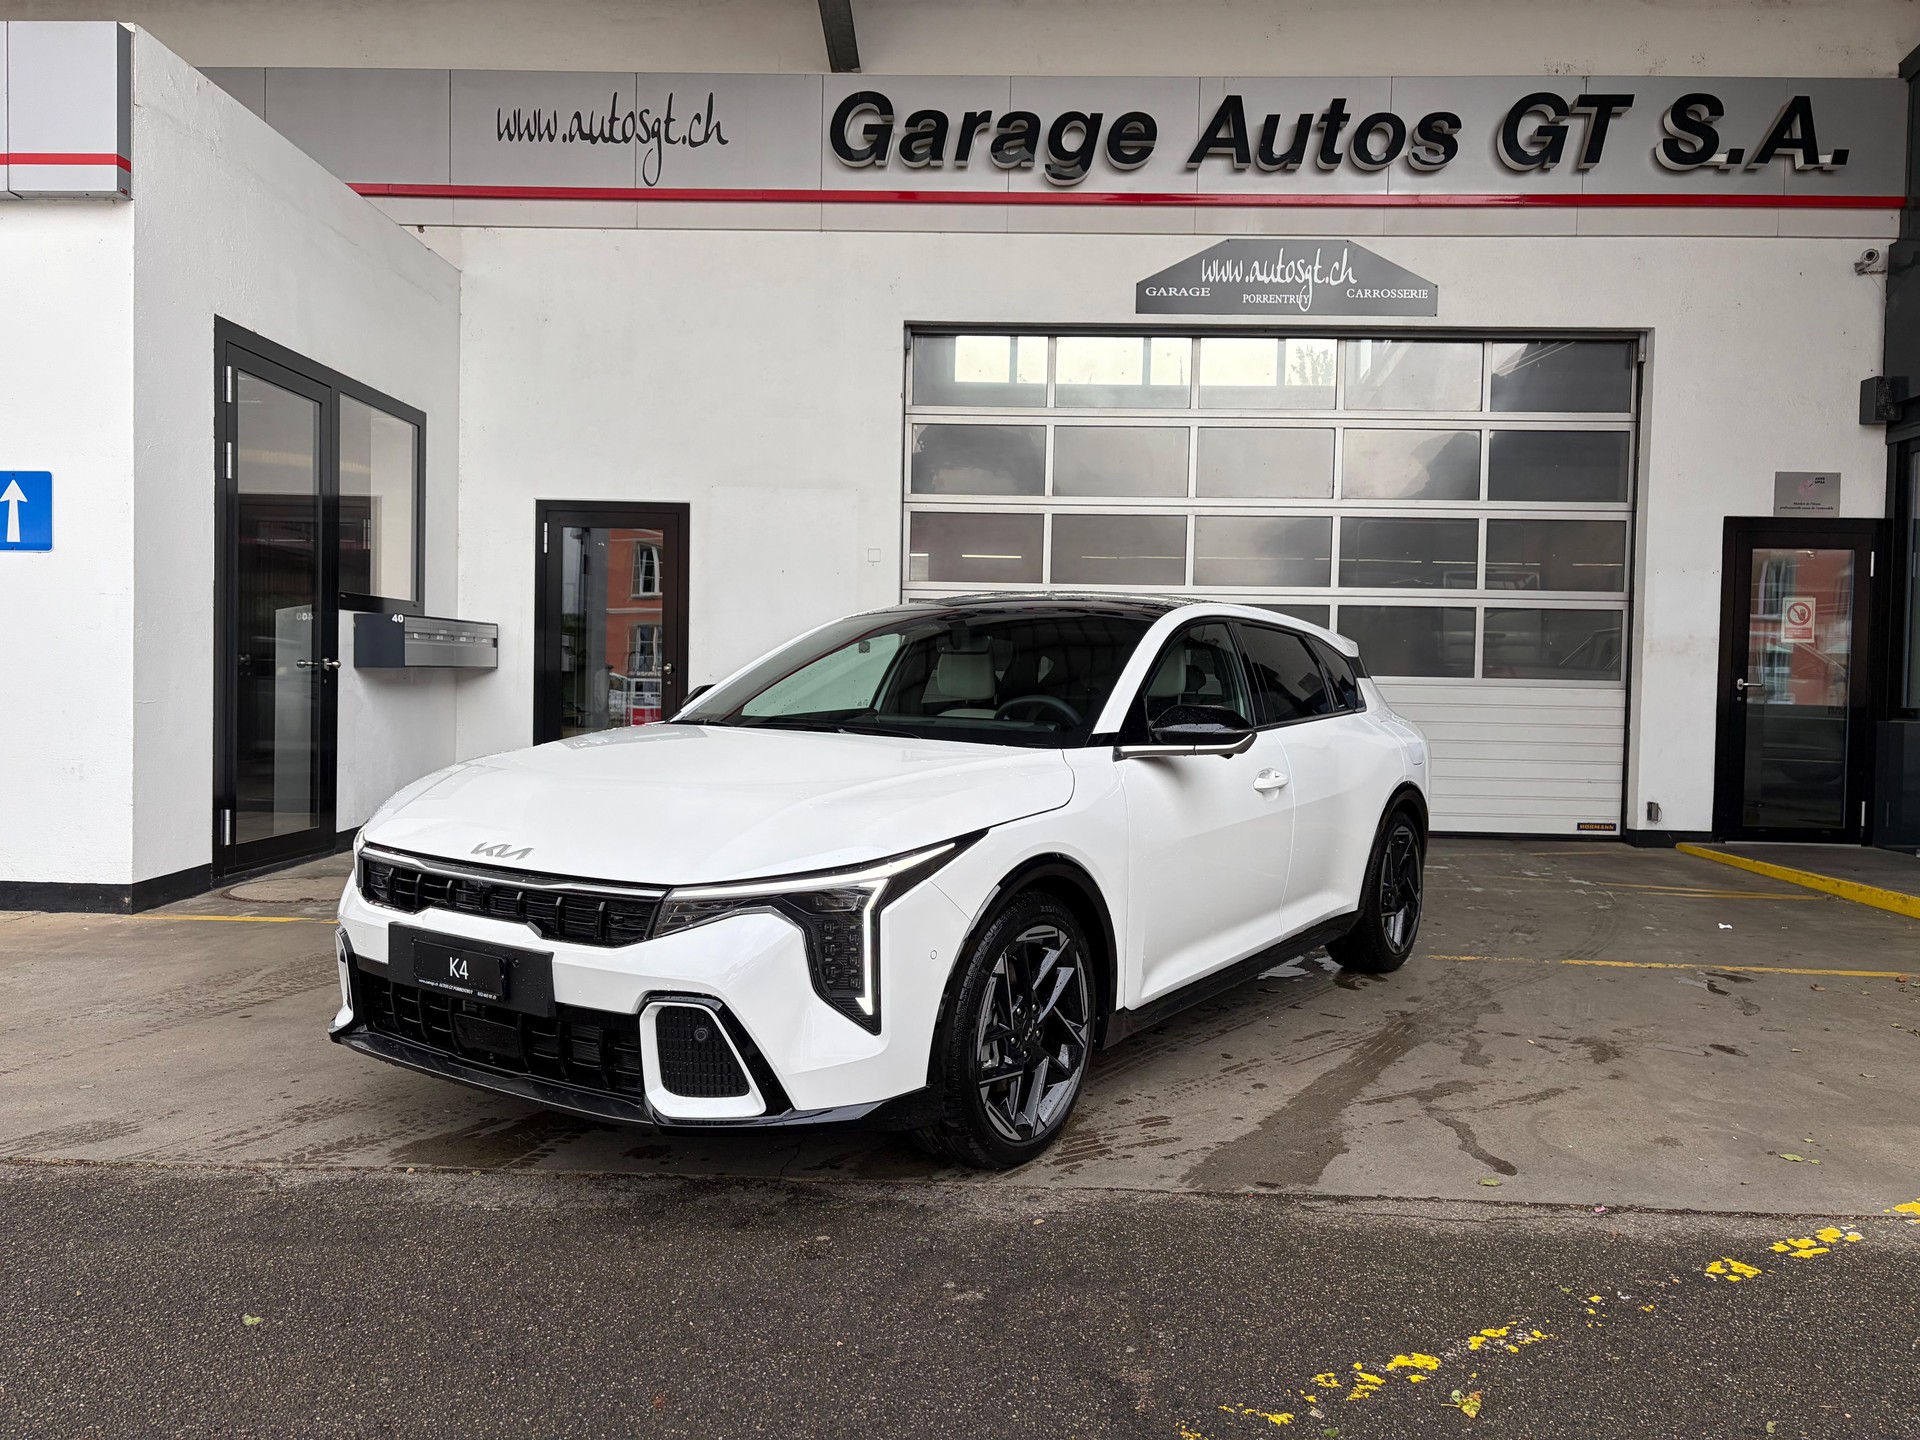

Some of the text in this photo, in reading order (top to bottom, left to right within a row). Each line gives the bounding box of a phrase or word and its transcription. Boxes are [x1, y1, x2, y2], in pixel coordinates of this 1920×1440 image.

[497, 91, 729, 187] www.autosgt.ch
[829, 90, 1850, 187] Garage Autos GT S.A.
[1201, 247, 1358, 312] www.autosgt.ch
[1145, 286, 1211, 298] GARAGE
[1242, 293, 1310, 304] PORRENTRUY
[1346, 288, 1429, 299] CARROSSERIE
[391, 613, 404, 623] 40
[449, 957, 469, 980] K4
